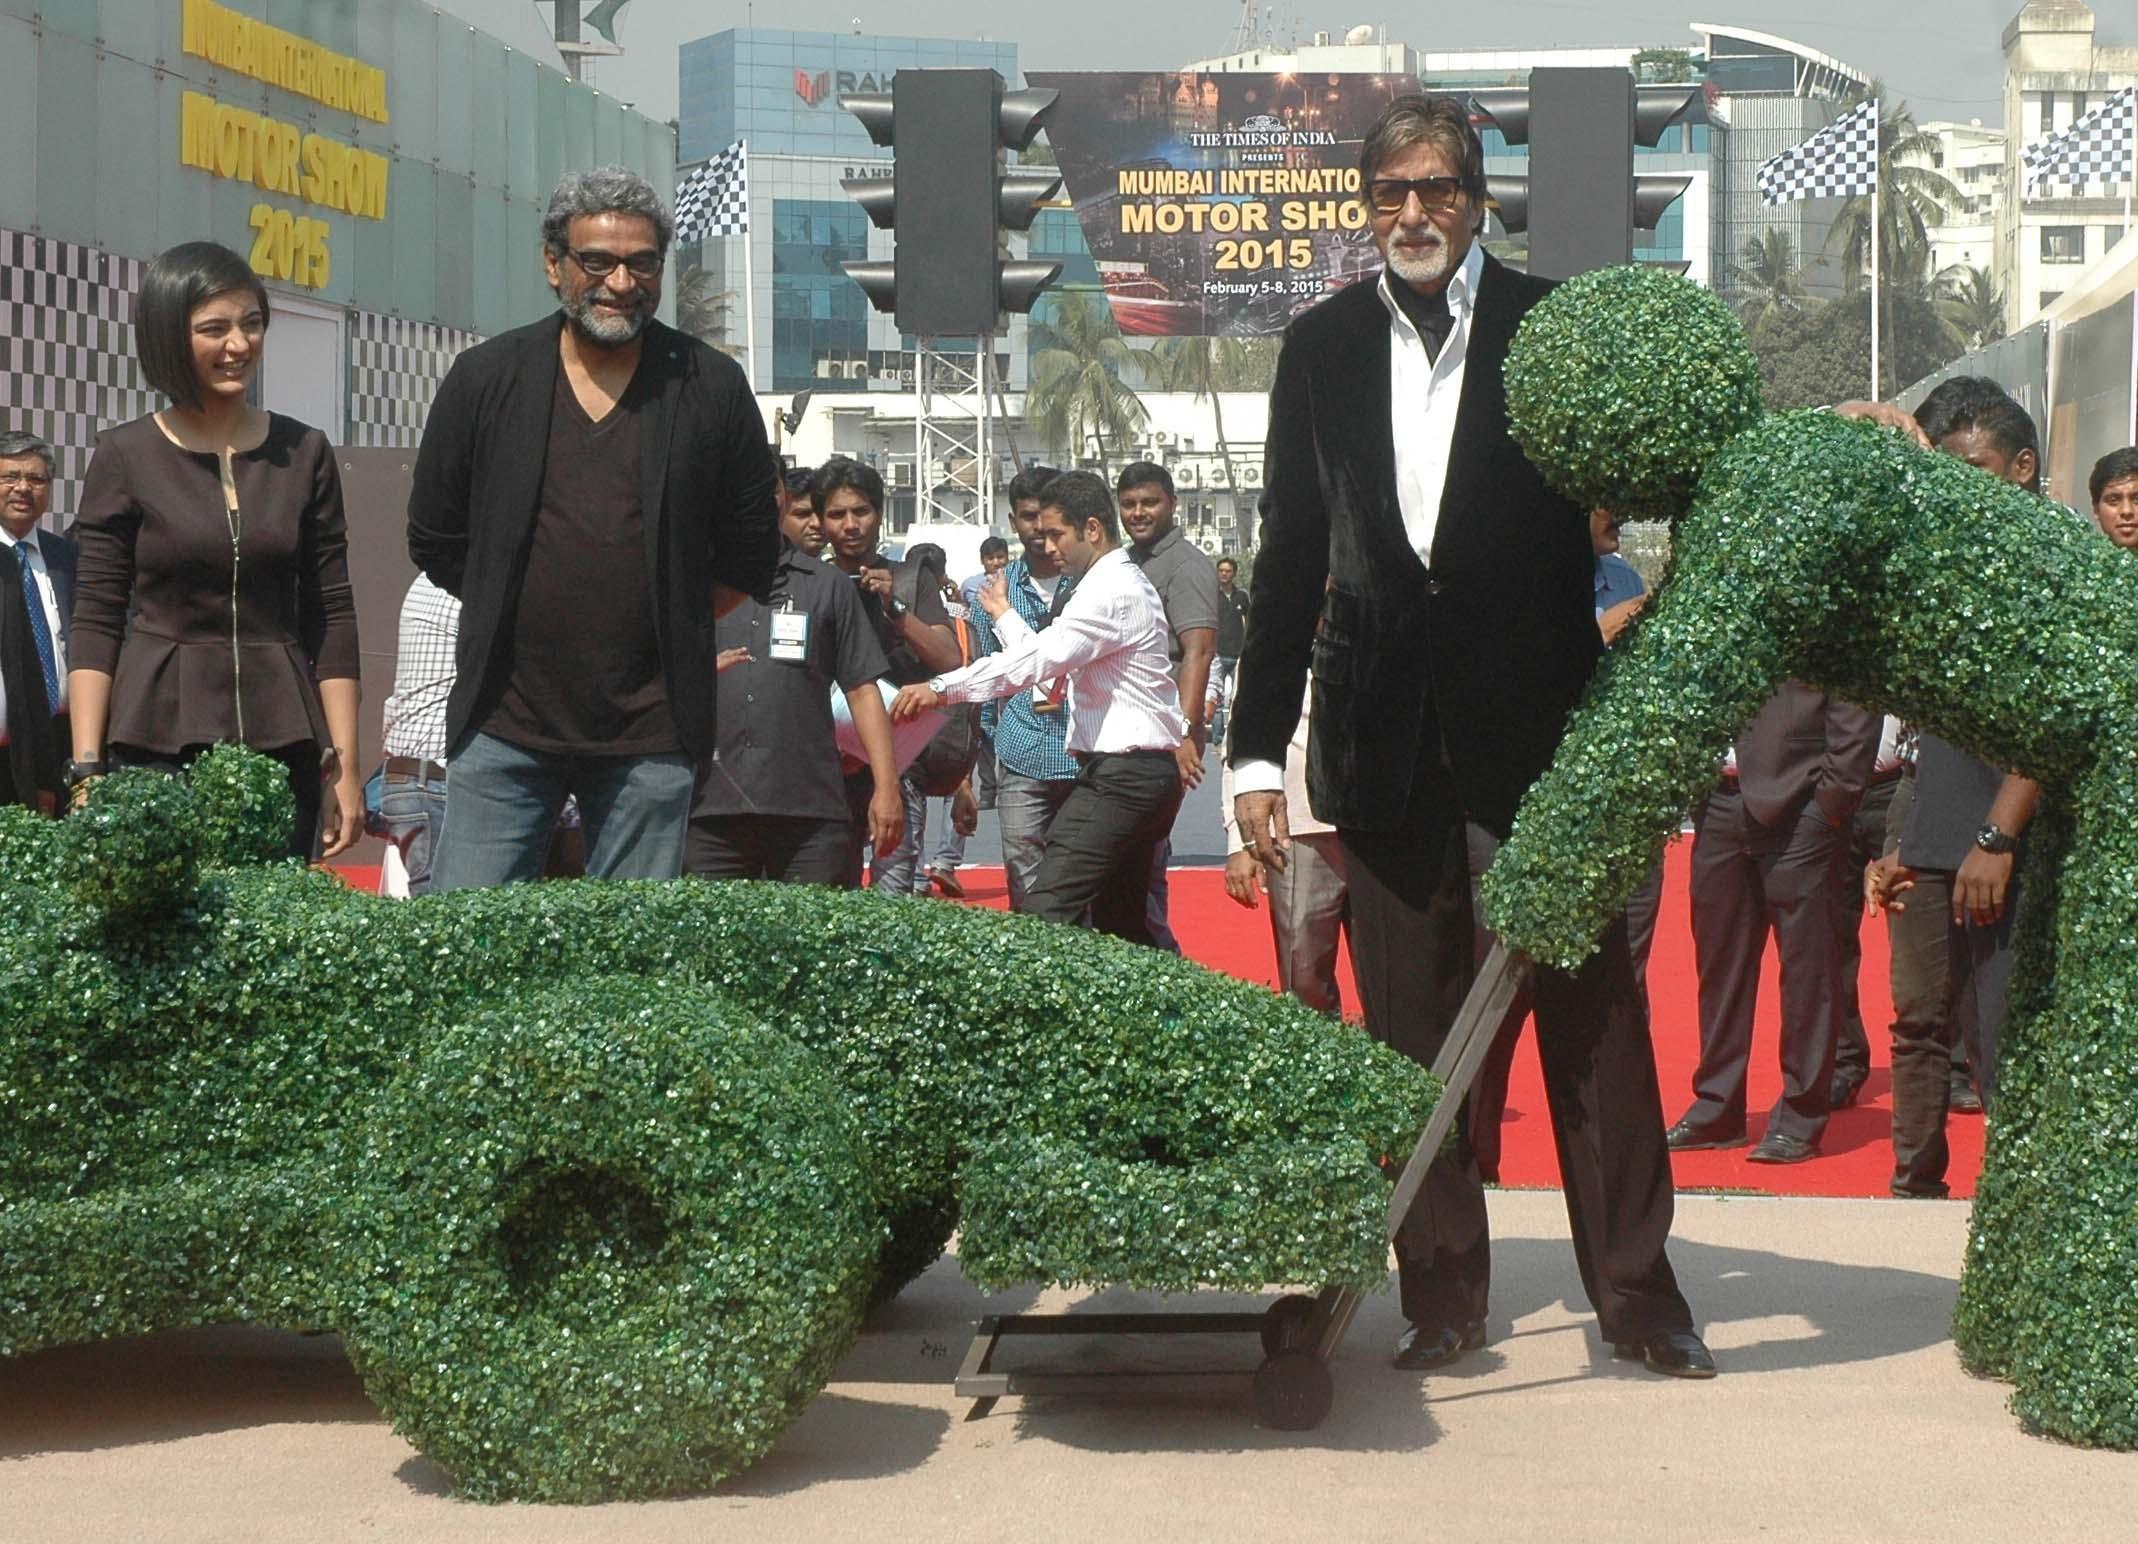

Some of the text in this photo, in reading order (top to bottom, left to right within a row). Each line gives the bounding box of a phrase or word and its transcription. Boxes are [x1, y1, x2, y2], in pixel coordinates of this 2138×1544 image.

[182, 0, 388, 125] MUMBAI INTERNATIONAL
[1190, 131, 1336, 147] THE TIMES OF INDIA
[181, 90, 389, 220] MOTOR SHOW
[1241, 153, 1285, 162] PRESENTS
[1118, 167, 1361, 195] MUMBAI INTERNATIO
[1121, 199, 1368, 233] MOTOR SHO
[249, 203, 330, 289] 2015
[1214, 239, 1313, 270] 2015
[1203, 280, 1324, 296] February 5-8, 2015
